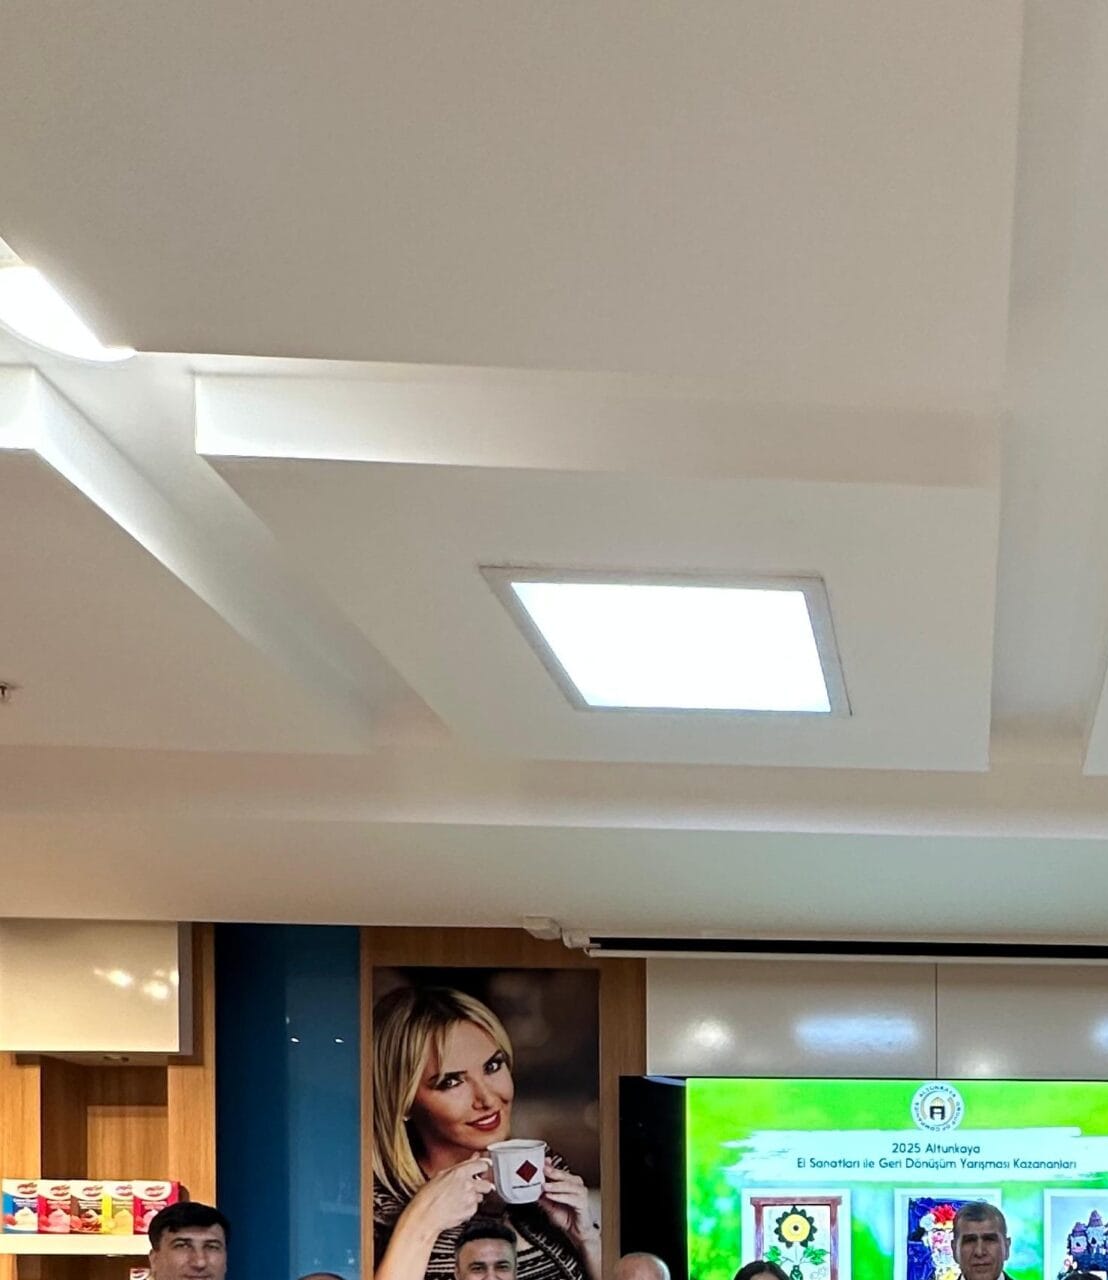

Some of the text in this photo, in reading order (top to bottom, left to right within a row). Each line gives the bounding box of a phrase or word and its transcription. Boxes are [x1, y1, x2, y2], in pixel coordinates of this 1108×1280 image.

[891, 1142, 982, 1156] 2025 Altunkaya
[797, 1156, 1078, 1171] El Sanatları ile Geri Dönüşüm Yarışması Kazananları
